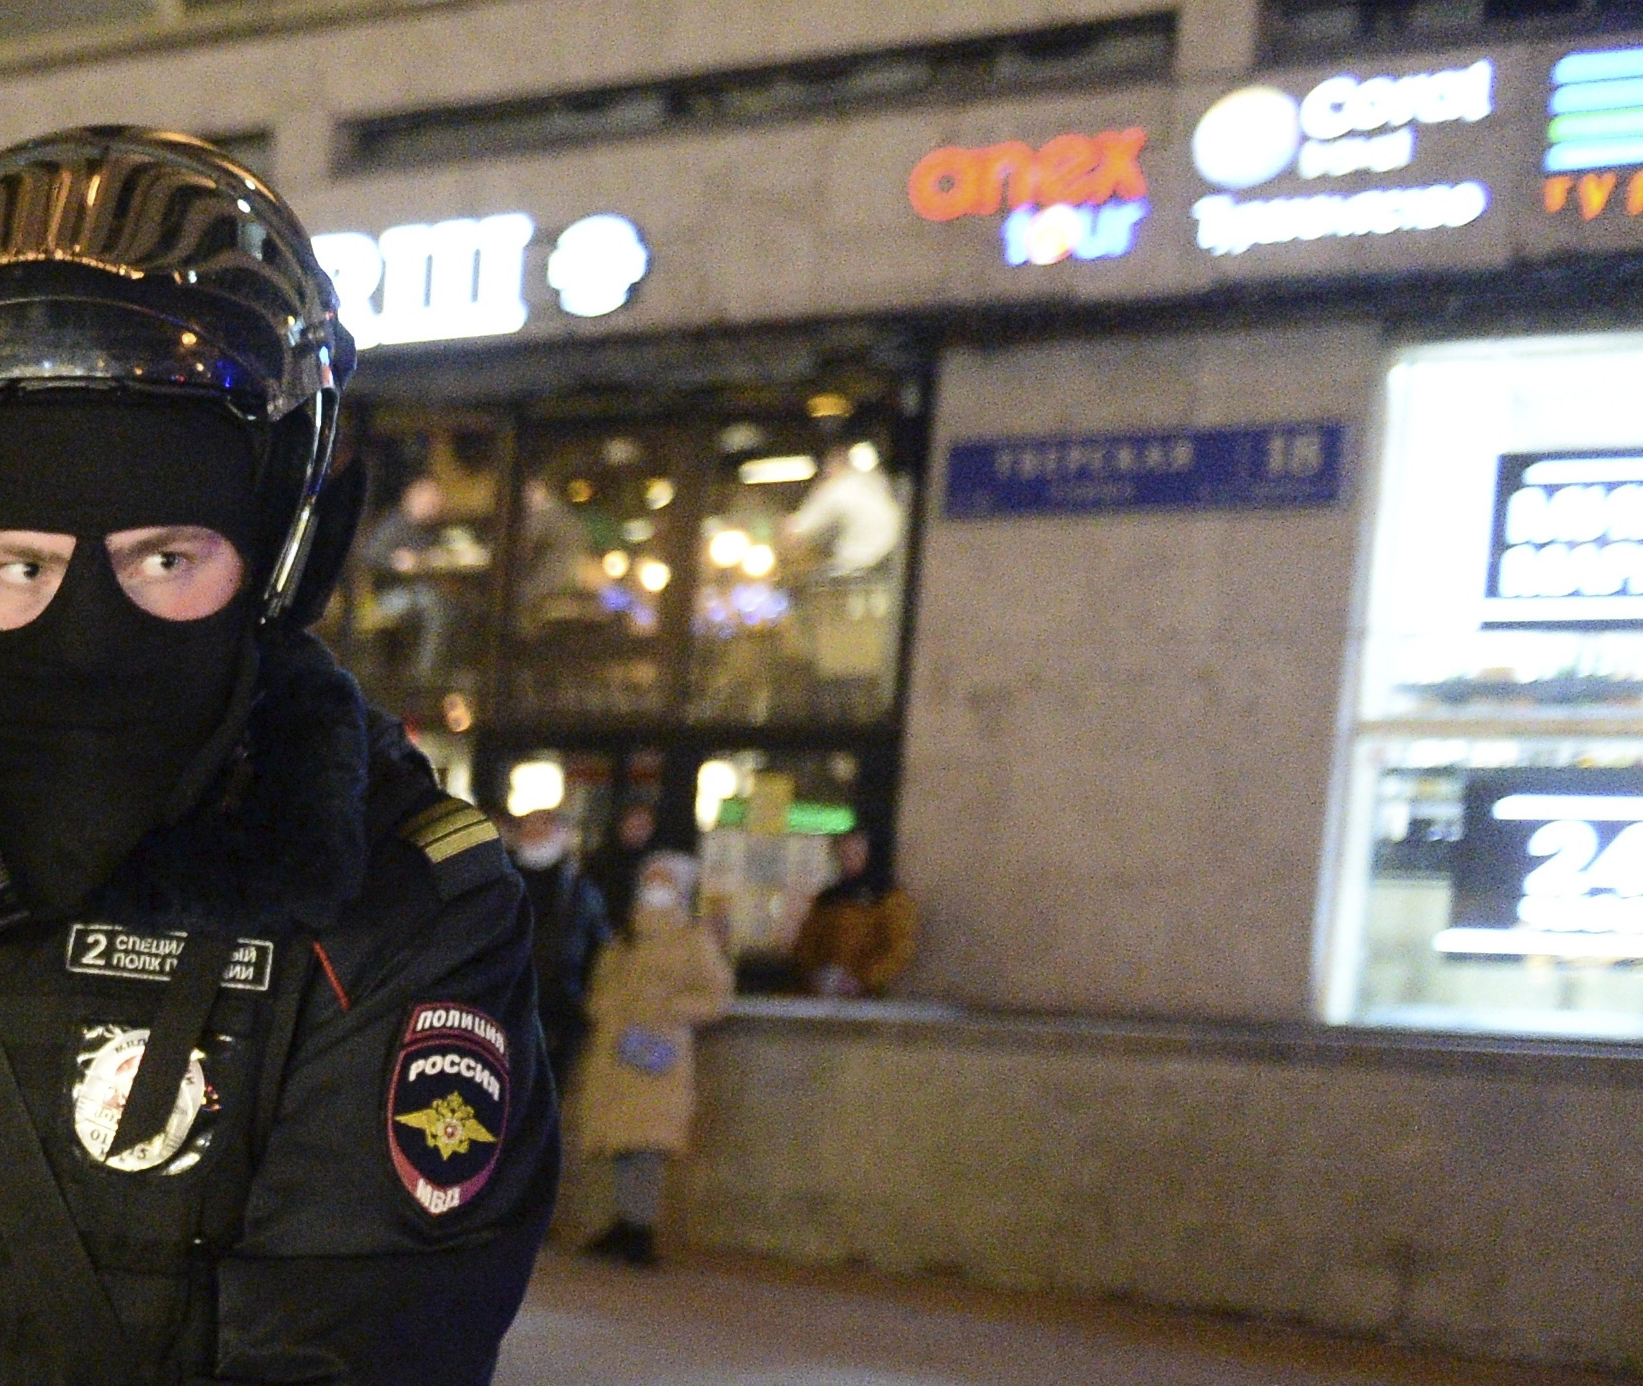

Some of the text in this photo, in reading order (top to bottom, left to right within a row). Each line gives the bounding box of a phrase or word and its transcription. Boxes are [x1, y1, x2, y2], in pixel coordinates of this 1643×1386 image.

[908, 127, 1147, 222] anex
[1001, 198, 1152, 268] tour
[81, 933, 108, 966] 2
[112, 952, 161, 973] ПОЛК
[416, 1008, 506, 1055] ПОЛИЦИЯ
[408, 1053, 501, 1102] РОССИЯ
[416, 1177, 462, 1216] МВД
